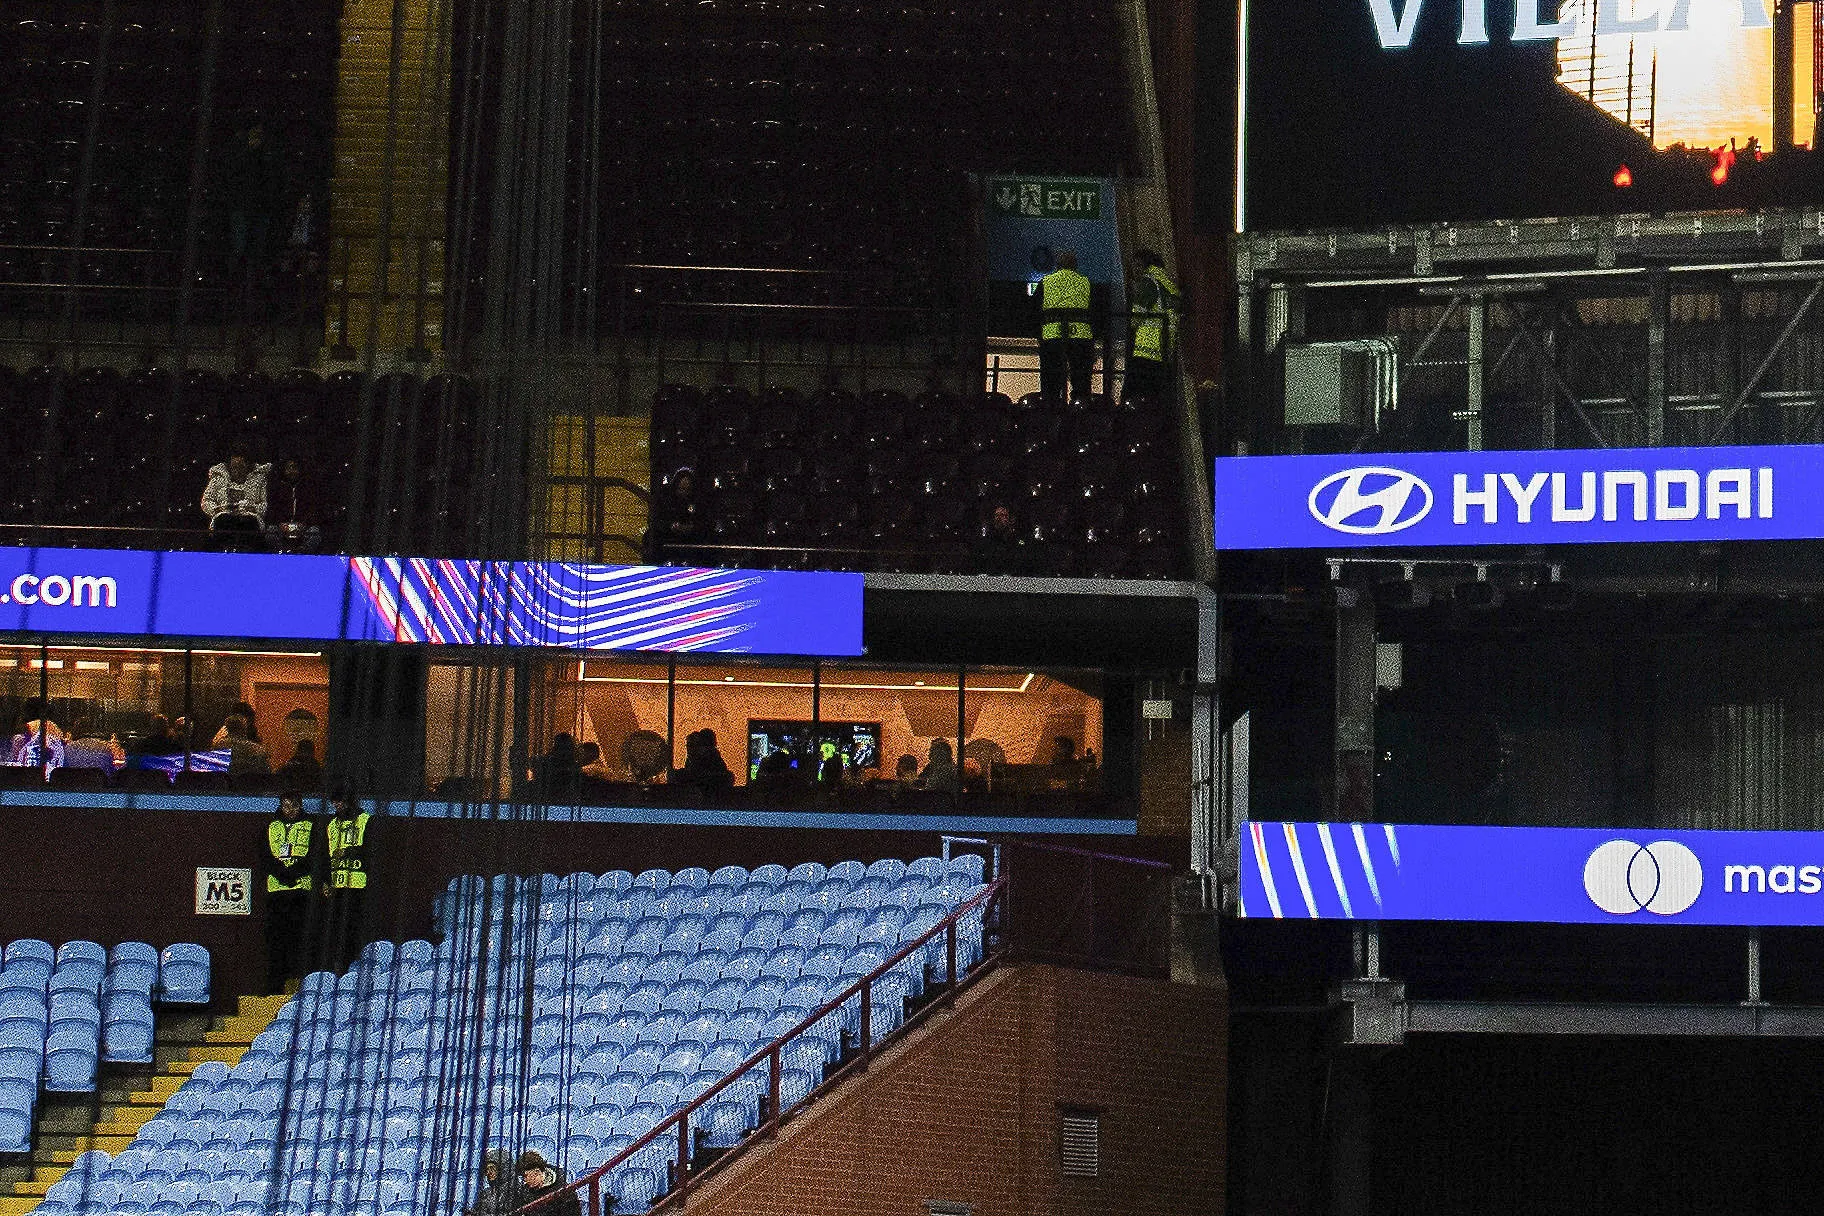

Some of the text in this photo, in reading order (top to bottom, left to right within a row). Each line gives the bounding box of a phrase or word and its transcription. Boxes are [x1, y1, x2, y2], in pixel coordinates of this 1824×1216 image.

[1047, 190, 1096, 211] EXIT
[1452, 467, 1774, 524] HYUNDAI
[0, 573, 117, 607] .com
[206, 882, 244, 902] M5
